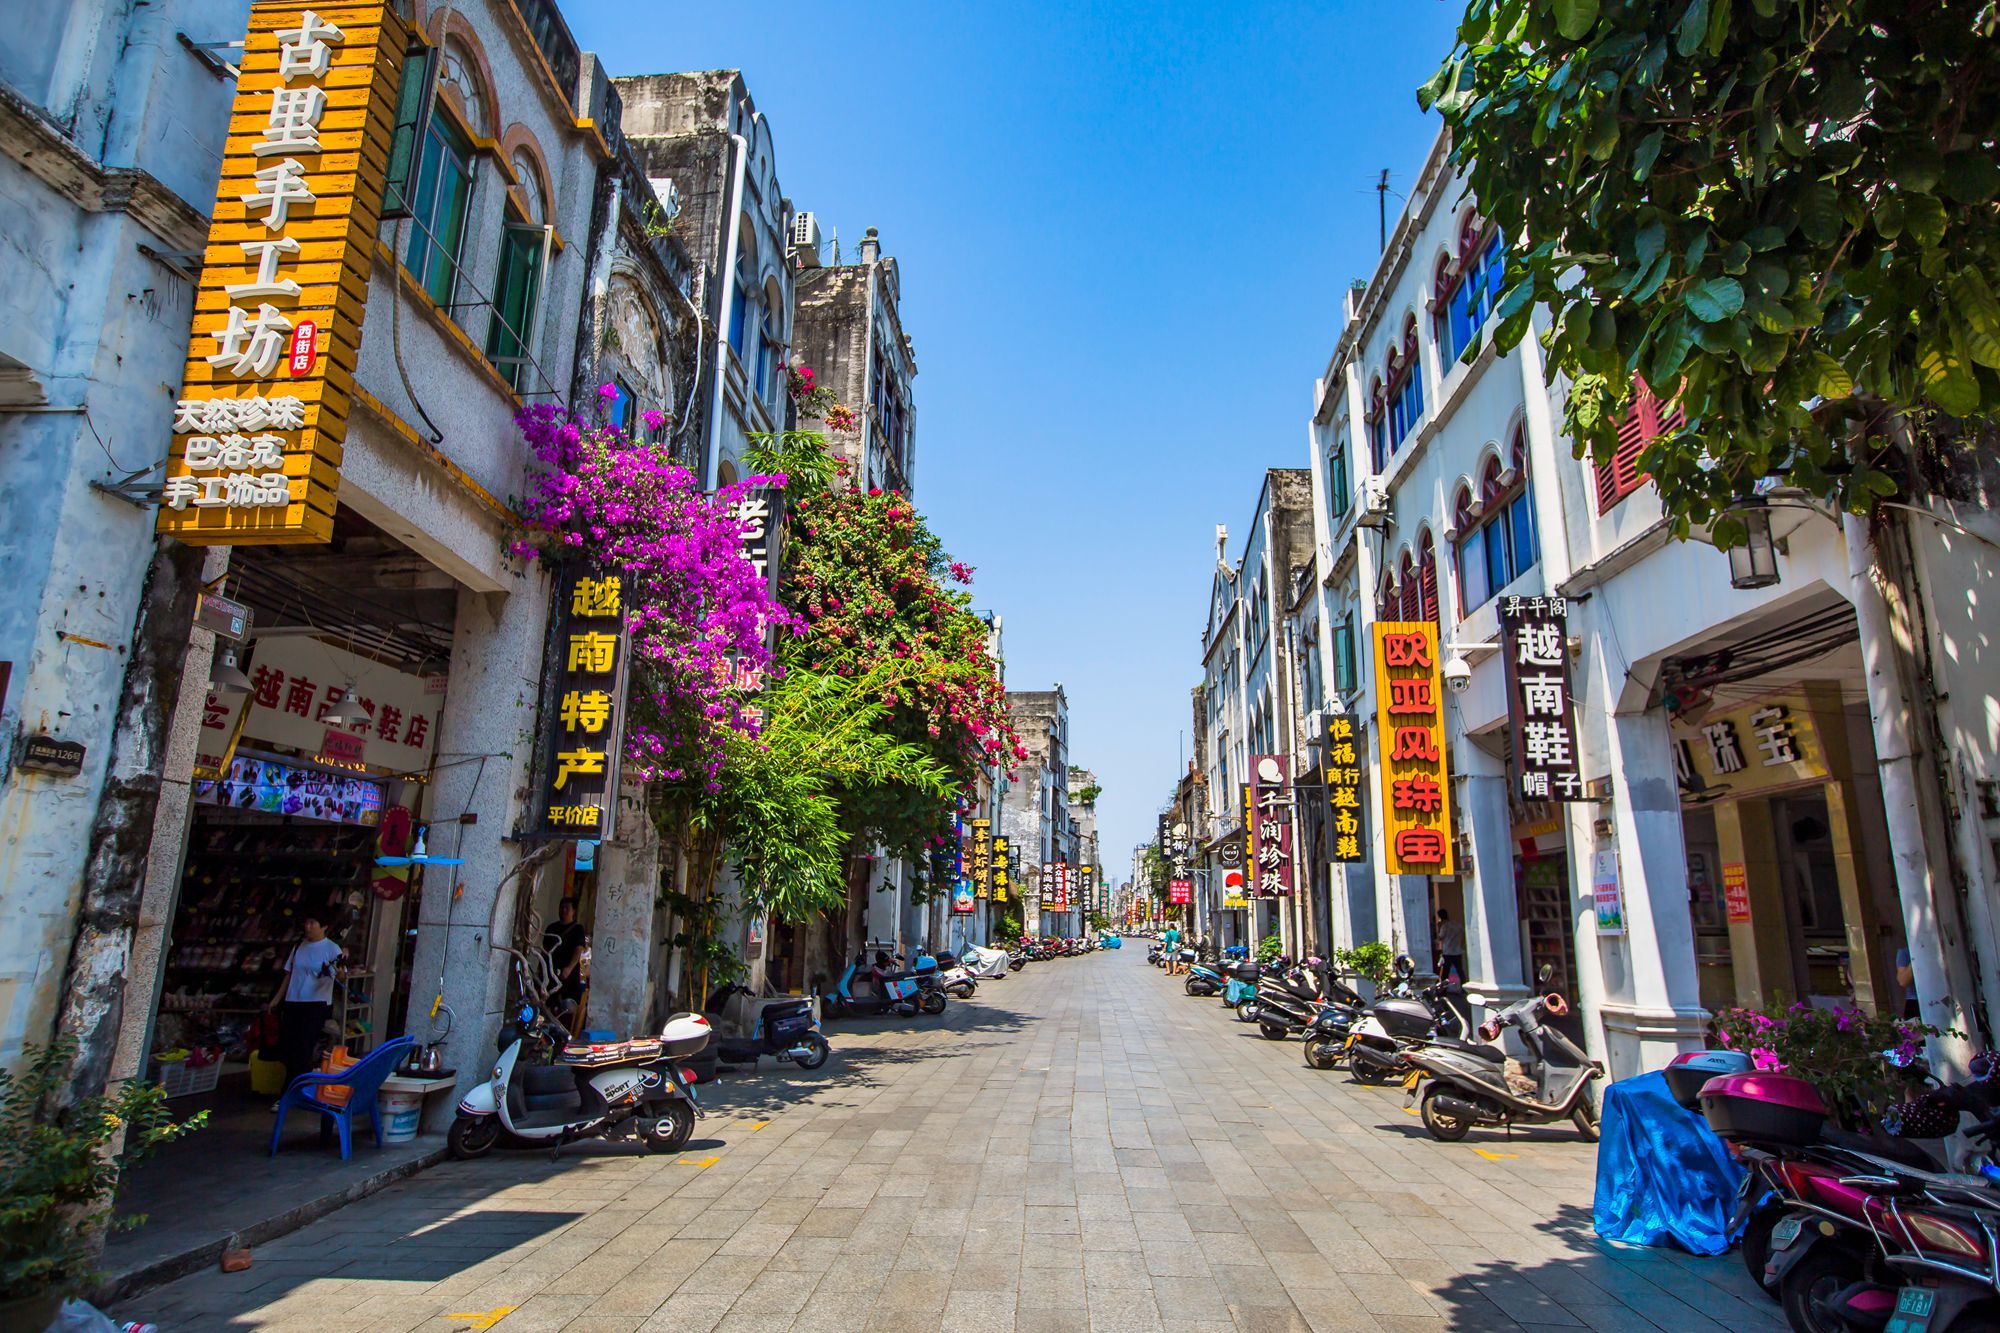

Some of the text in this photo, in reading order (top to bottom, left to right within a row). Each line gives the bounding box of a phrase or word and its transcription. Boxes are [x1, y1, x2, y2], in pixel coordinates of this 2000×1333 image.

[205, 9, 345, 379] 古里手工坊
[293, 324, 314, 371] 西街店
[172, 394, 305, 434] 天然珍珠
[184, 434, 288, 472] 巴洛克
[163, 474, 291, 511] 手工饰品
[1505, 595, 1568, 618] 昇平阁
[553, 576, 622, 791] 越南特产
[1517, 623, 1572, 767] 越南鞋
[1329, 719, 1355, 765] 恒福
[1383, 631, 1446, 864] 欧亚风珠宝
[1327, 768, 1360, 784] 商行
[1523, 771, 1582, 797] 帽子
[547, 805, 600, 825] 平价店
[1330, 787, 1361, 860] 越南鞋
[1257, 791, 1288, 895] 千润珍珠
[992, 839, 1009, 902] 北海味道
